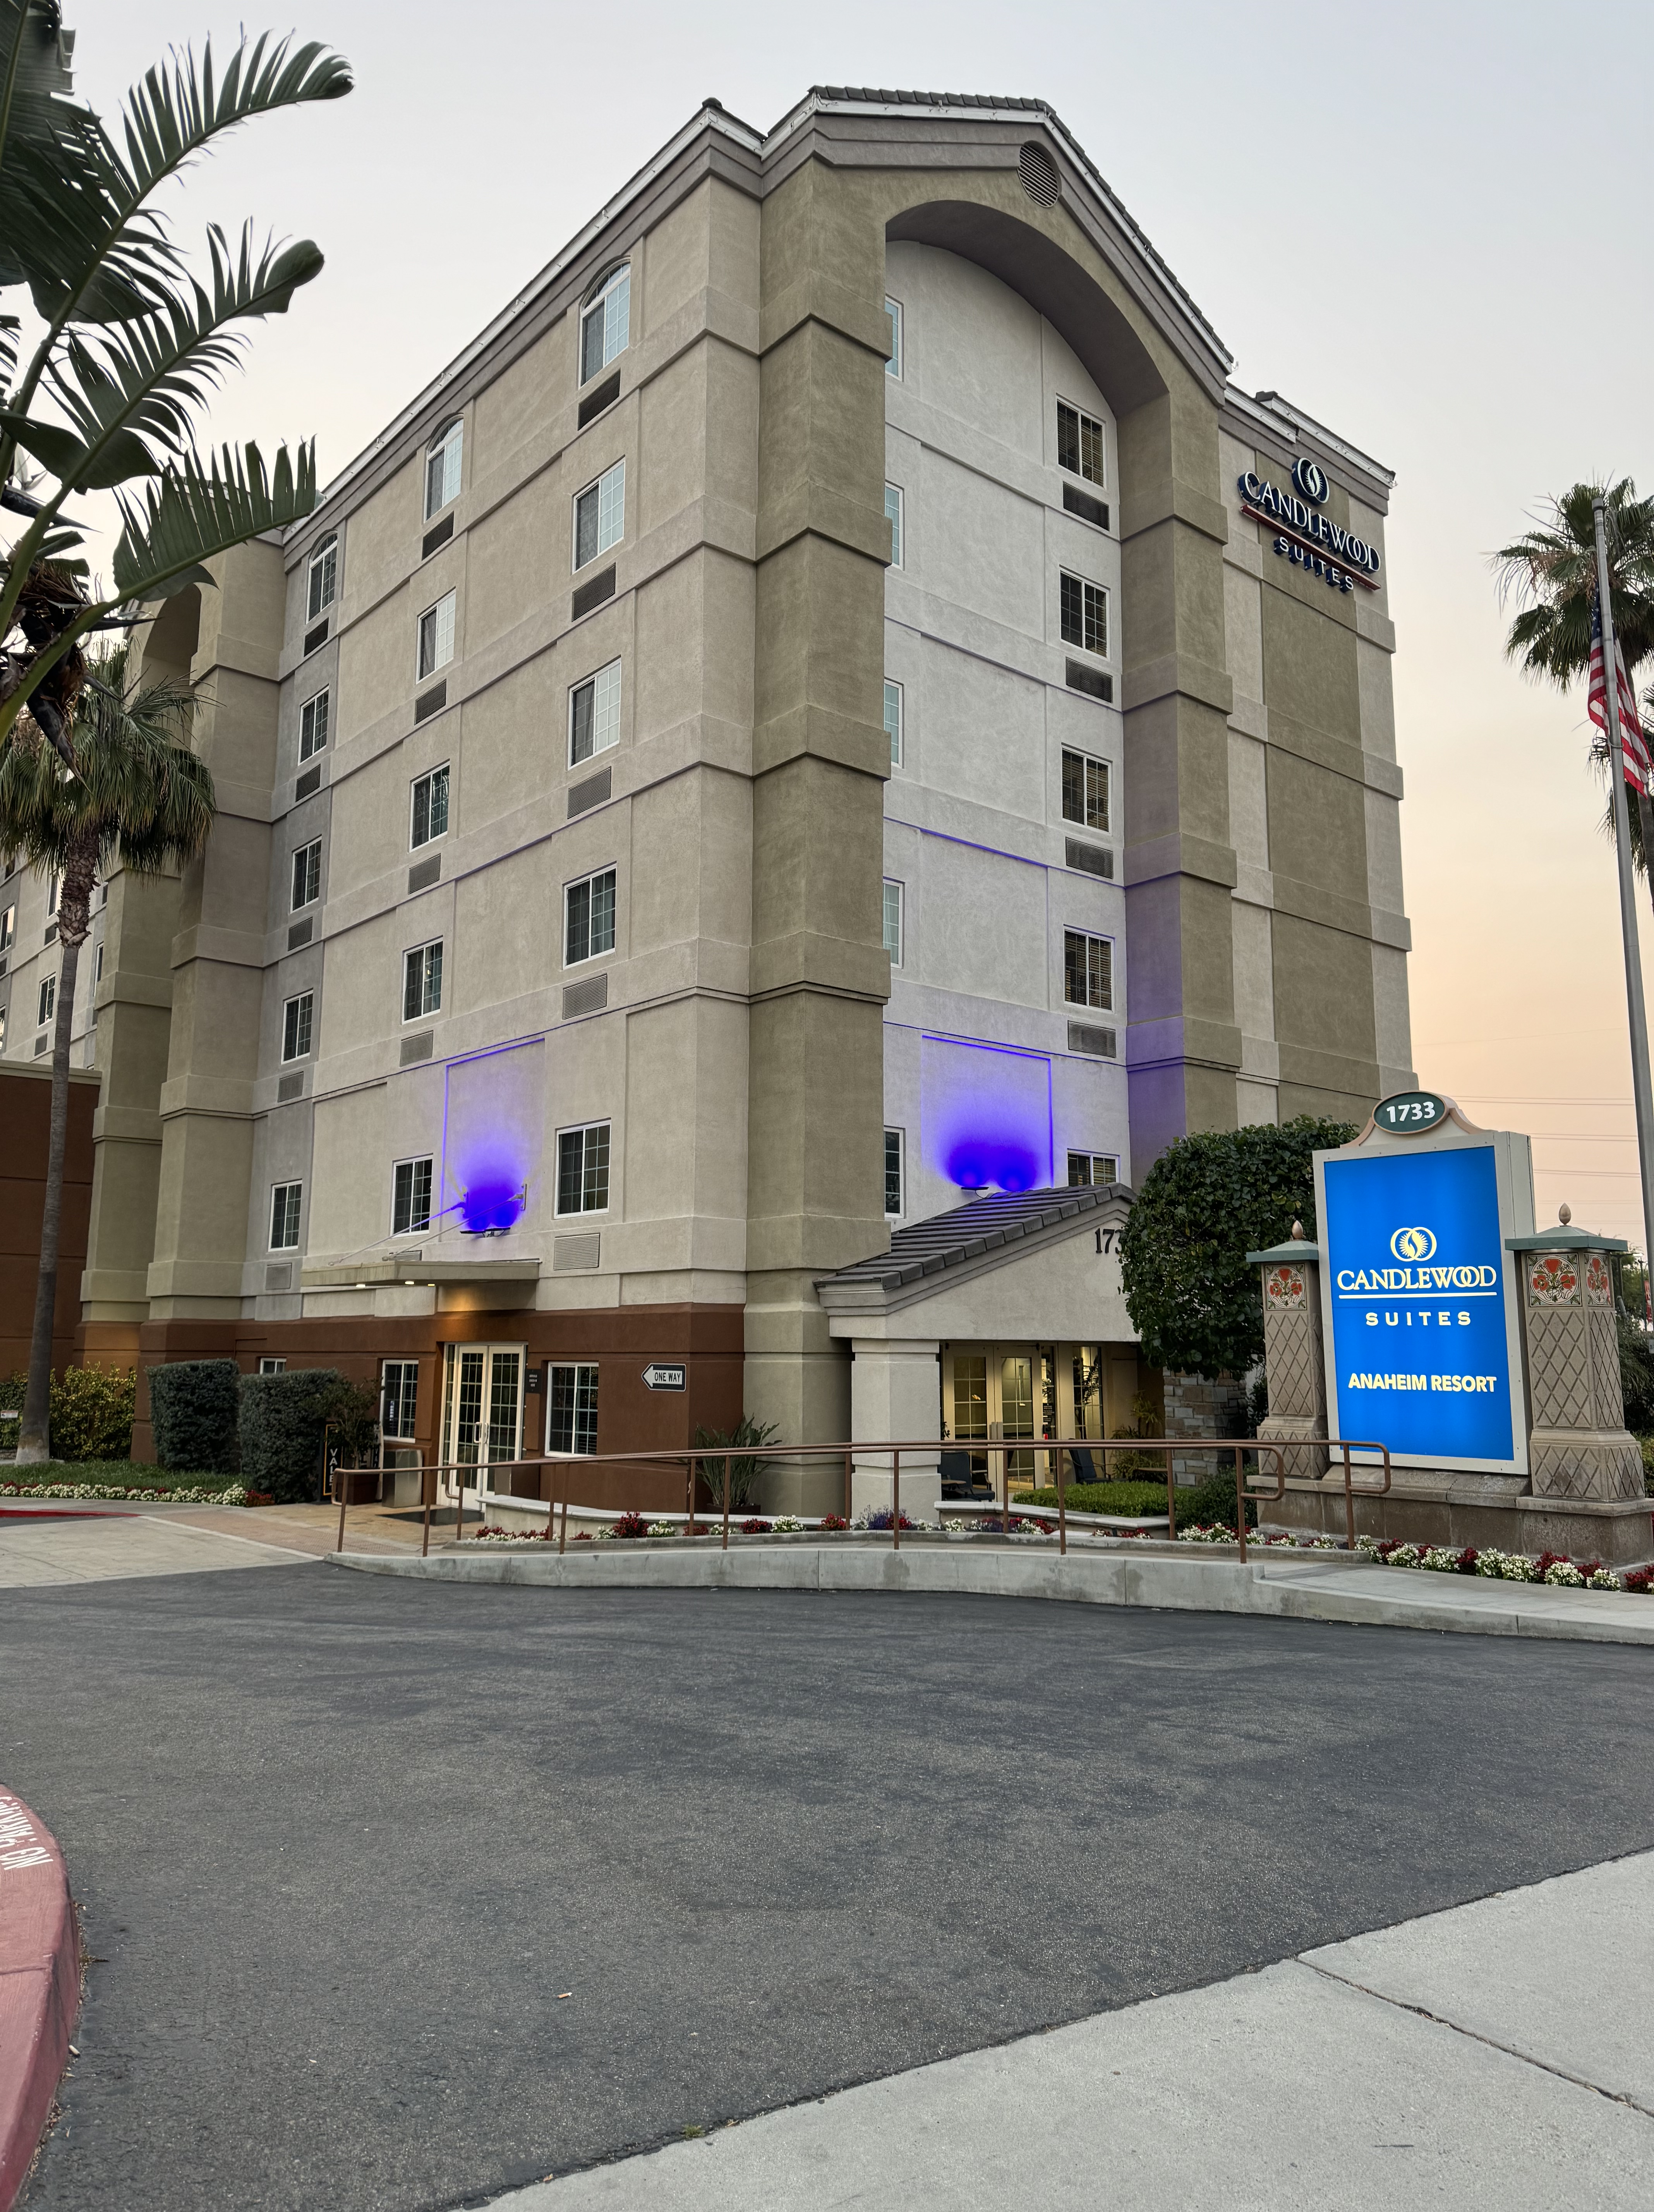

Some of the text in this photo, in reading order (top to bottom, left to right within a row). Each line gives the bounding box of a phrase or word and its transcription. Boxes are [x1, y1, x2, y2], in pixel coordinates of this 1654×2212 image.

[1239, 471, 1381, 573] CANDLEWOOD
[1276, 536, 1354, 591] SUITES
[1386, 1101, 1435, 1123] 1733
[1337, 1266, 1496, 1290] CANDLEWOOD
[1366, 1311, 1471, 1326] SUITES
[654, 1372, 681, 1382] ONE WAY
[1348, 1373, 1497, 1392] ANAHEIM RESORT
[0, 1846, 54, 1870] NO
